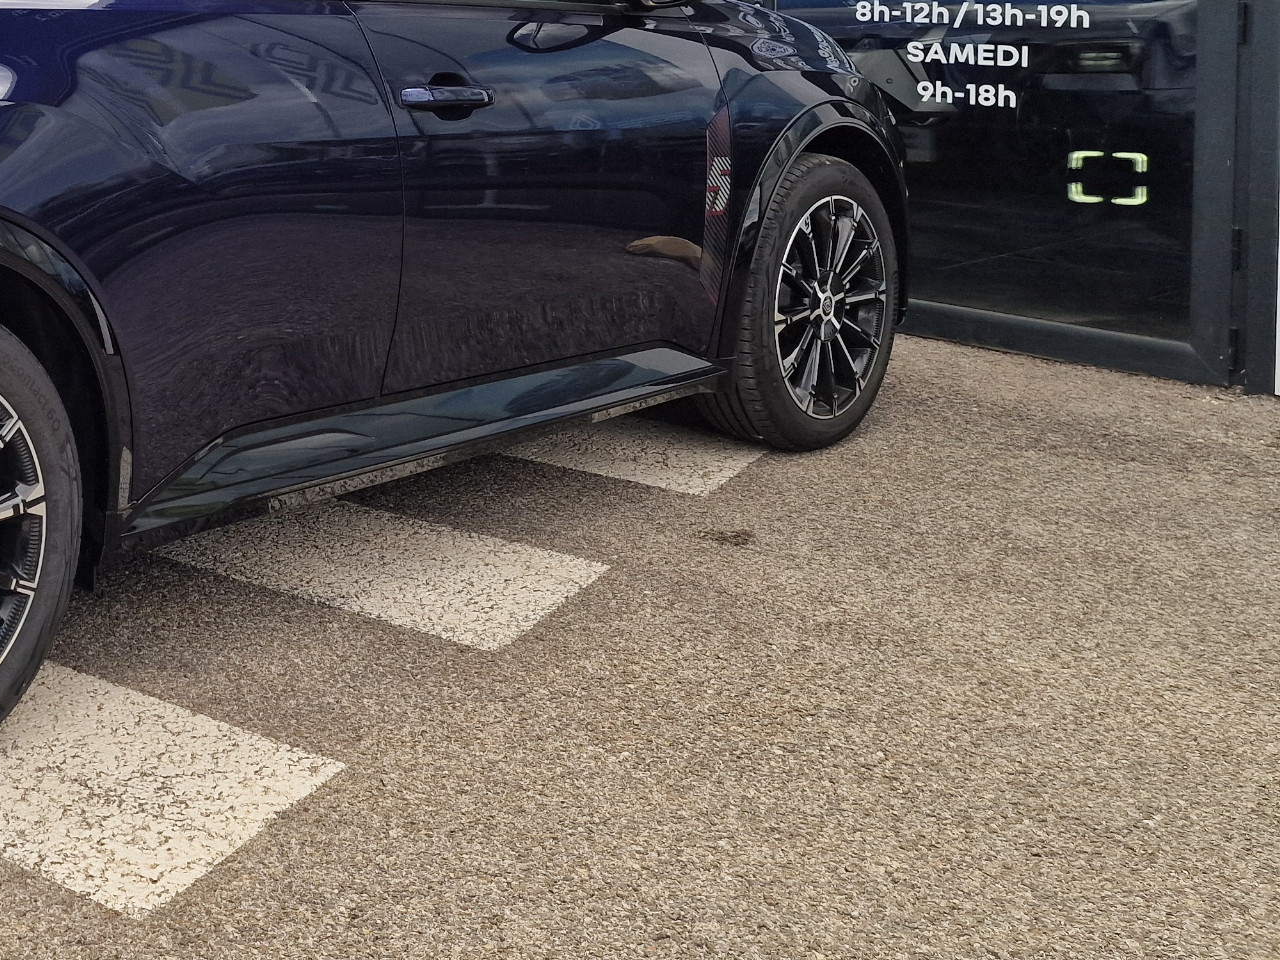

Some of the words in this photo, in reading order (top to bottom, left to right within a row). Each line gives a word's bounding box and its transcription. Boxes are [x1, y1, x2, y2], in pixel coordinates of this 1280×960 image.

[855, 0, 950, 24] 8h-12h
[973, 2, 1090, 28] 13h-19h
[906, 41, 1029, 68] SAMEDI
[916, 80, 1017, 108] 9h-18h
